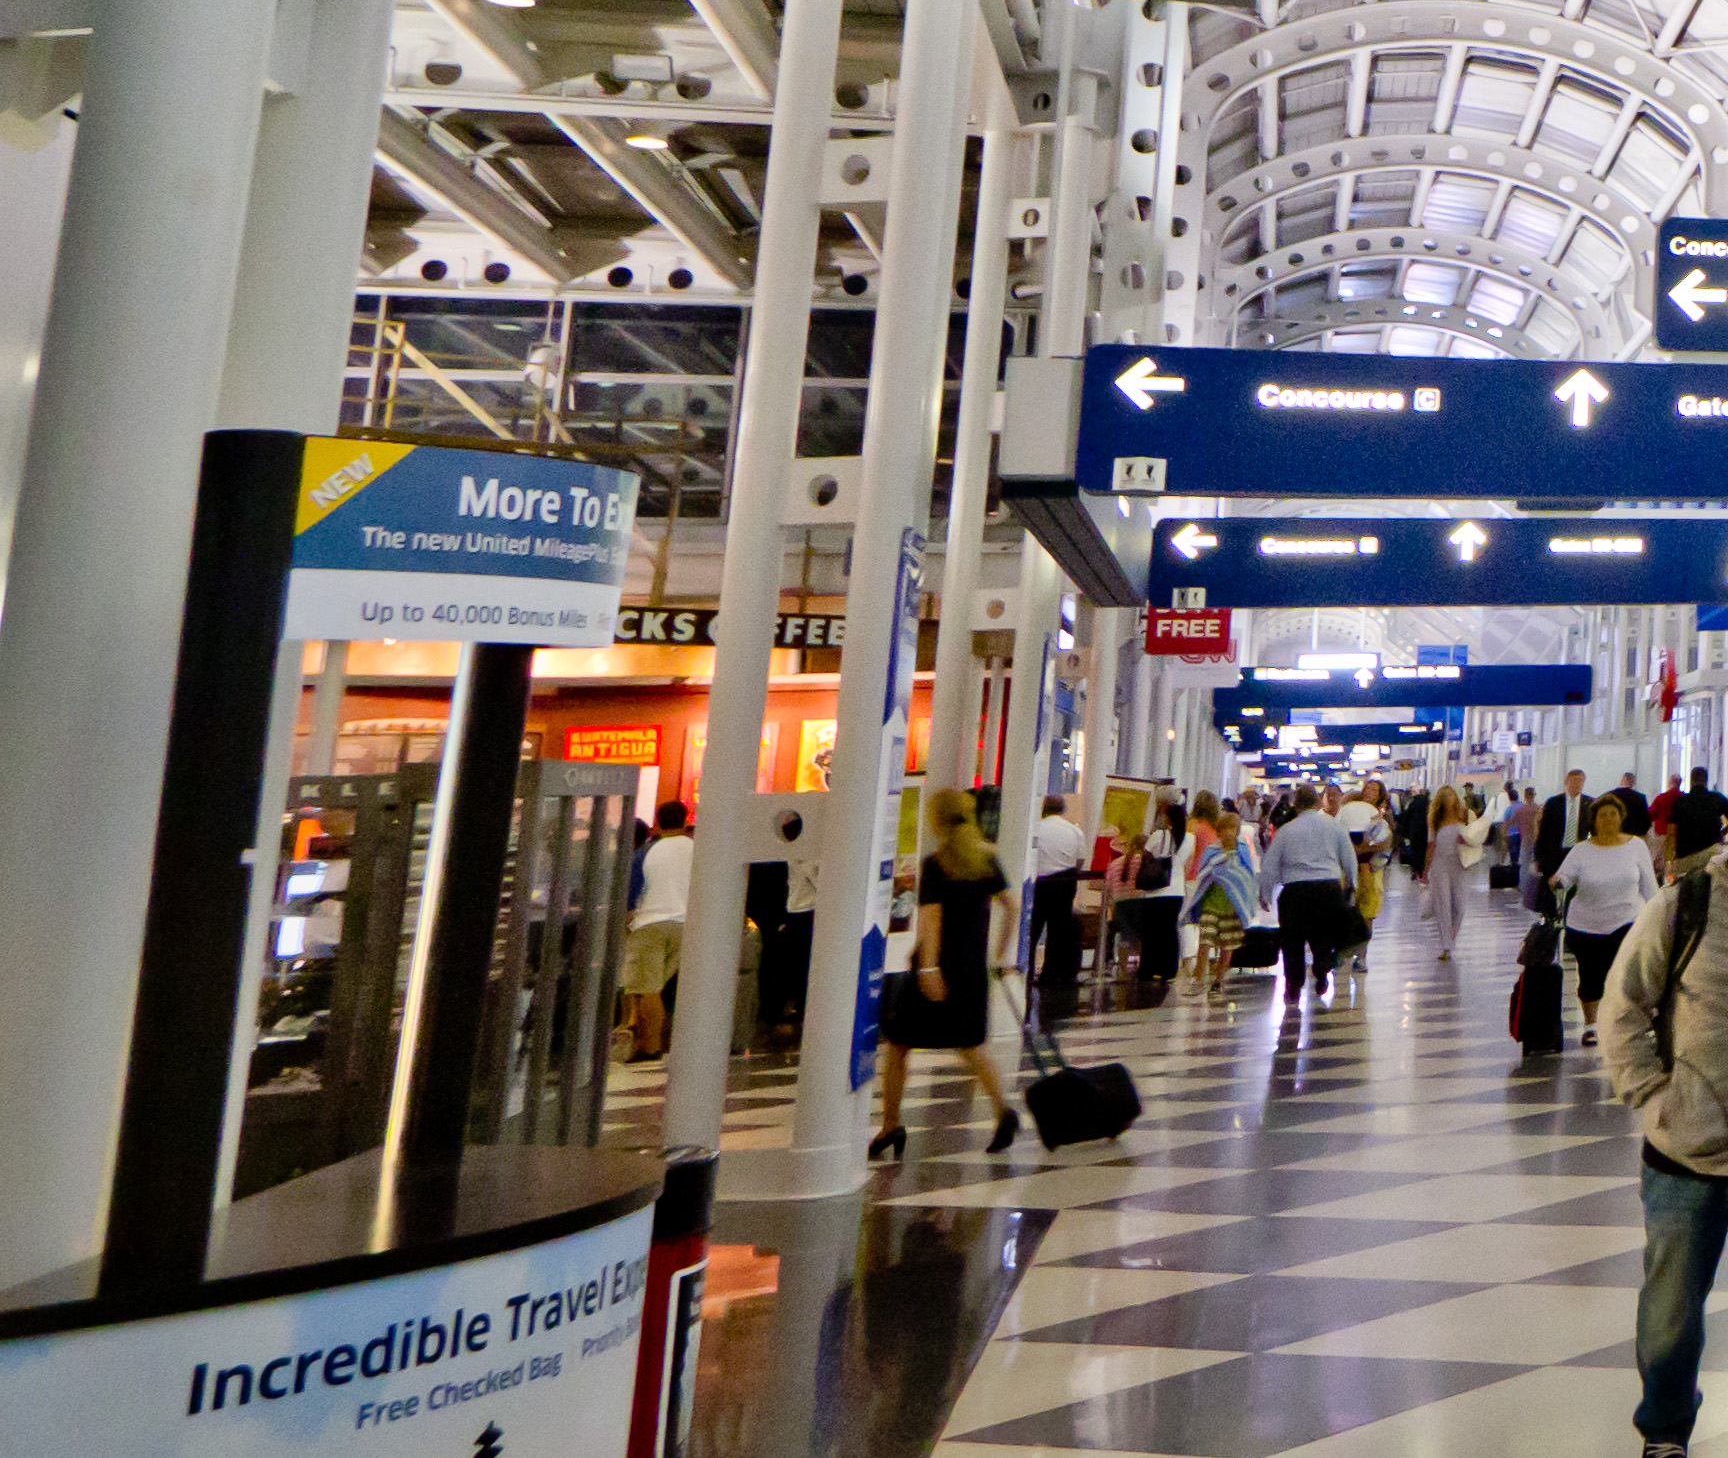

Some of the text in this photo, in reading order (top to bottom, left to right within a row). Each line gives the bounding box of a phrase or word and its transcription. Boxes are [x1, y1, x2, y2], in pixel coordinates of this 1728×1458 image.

[1256, 383, 1405, 410] Concourse
[308, 452, 375, 510] NEW
[458, 475, 562, 525] More
[569, 486, 601, 530] To
[360, 525, 406, 550] The
[411, 531, 462, 553] new
[466, 532, 530, 557] United
[361, 601, 394, 625] Up
[402, 603, 424, 623] to
[432, 604, 502, 626] 40,000
[508, 605, 555, 628] Bonus
[1155, 618, 1221, 639] FREE
[569, 741, 656, 759] ANTIGUA
[185, 1308, 492, 1417] Incredible
[505, 1265, 609, 1343] Travel
[355, 1395, 420, 1430] Free
[427, 1359, 525, 1411] Checked
[528, 1352, 564, 1382] Bag
